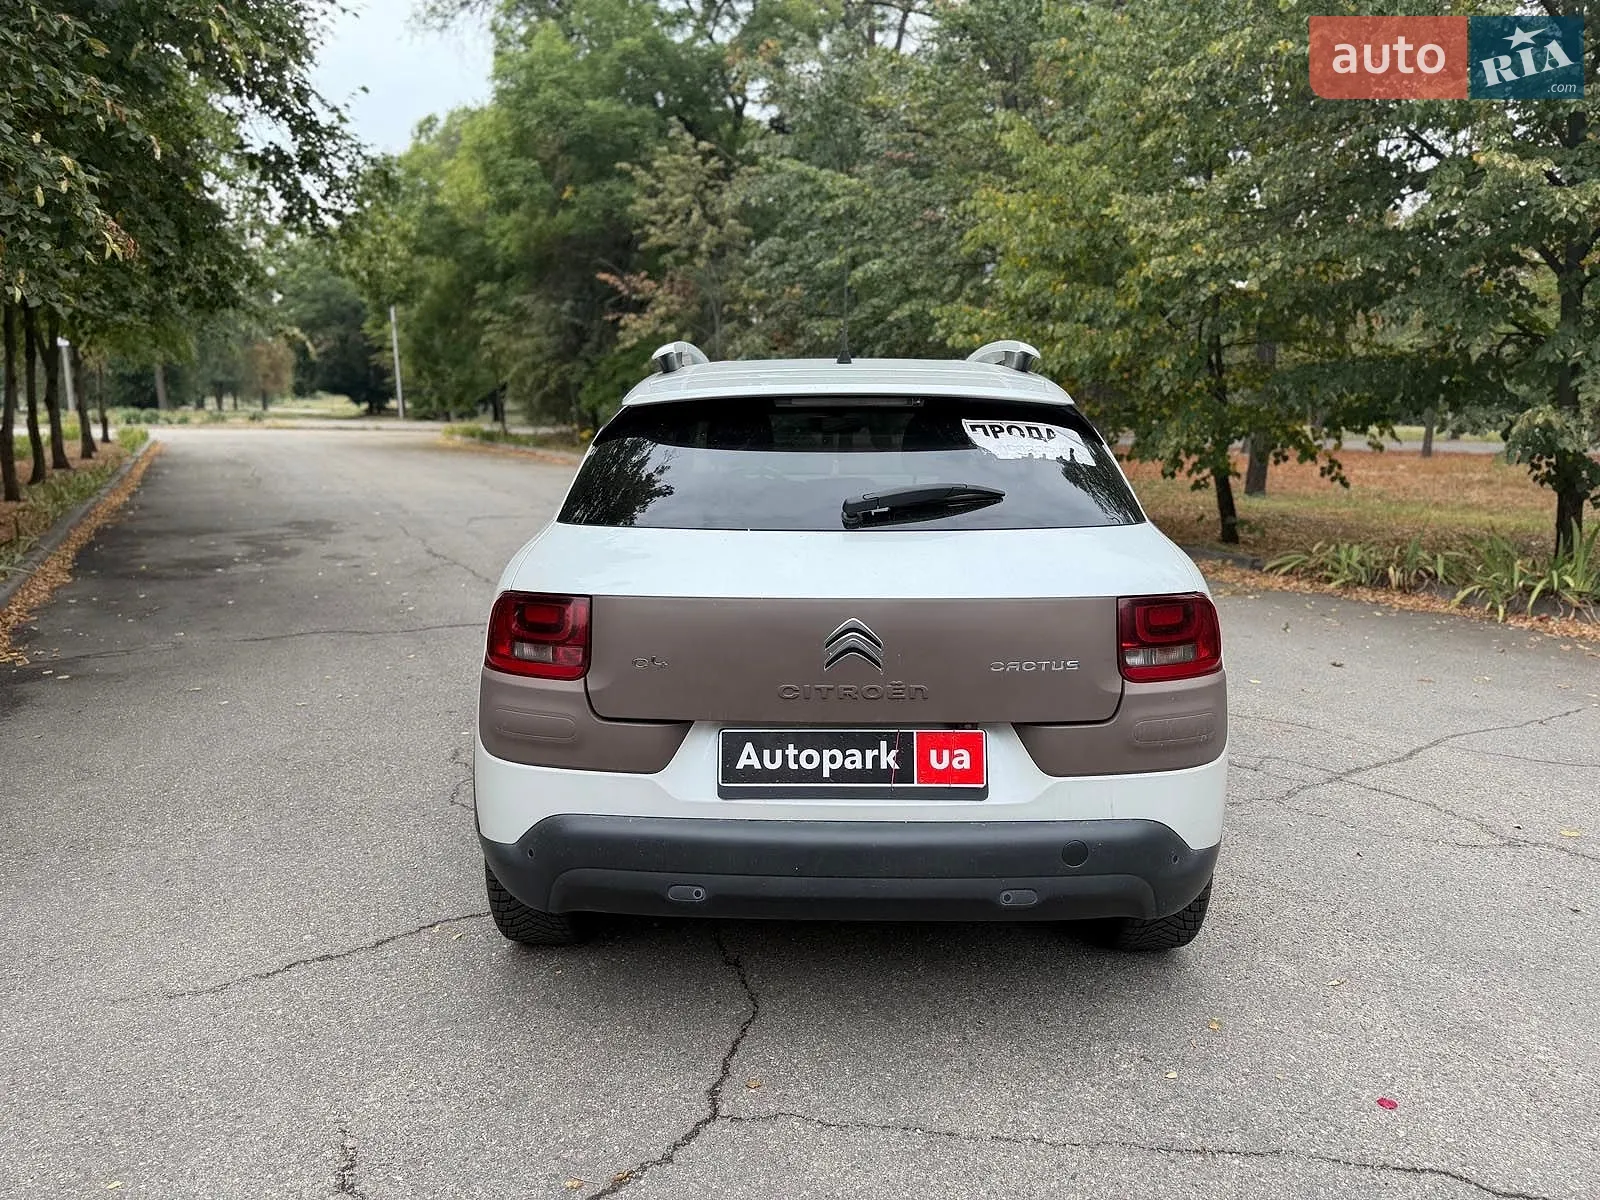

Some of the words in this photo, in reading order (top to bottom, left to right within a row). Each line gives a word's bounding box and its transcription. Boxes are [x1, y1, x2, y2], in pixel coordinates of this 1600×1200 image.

[990, 660, 1080, 672] CACTUS
[735, 741, 900, 778] Autopark
[929, 748, 971, 770] ua
